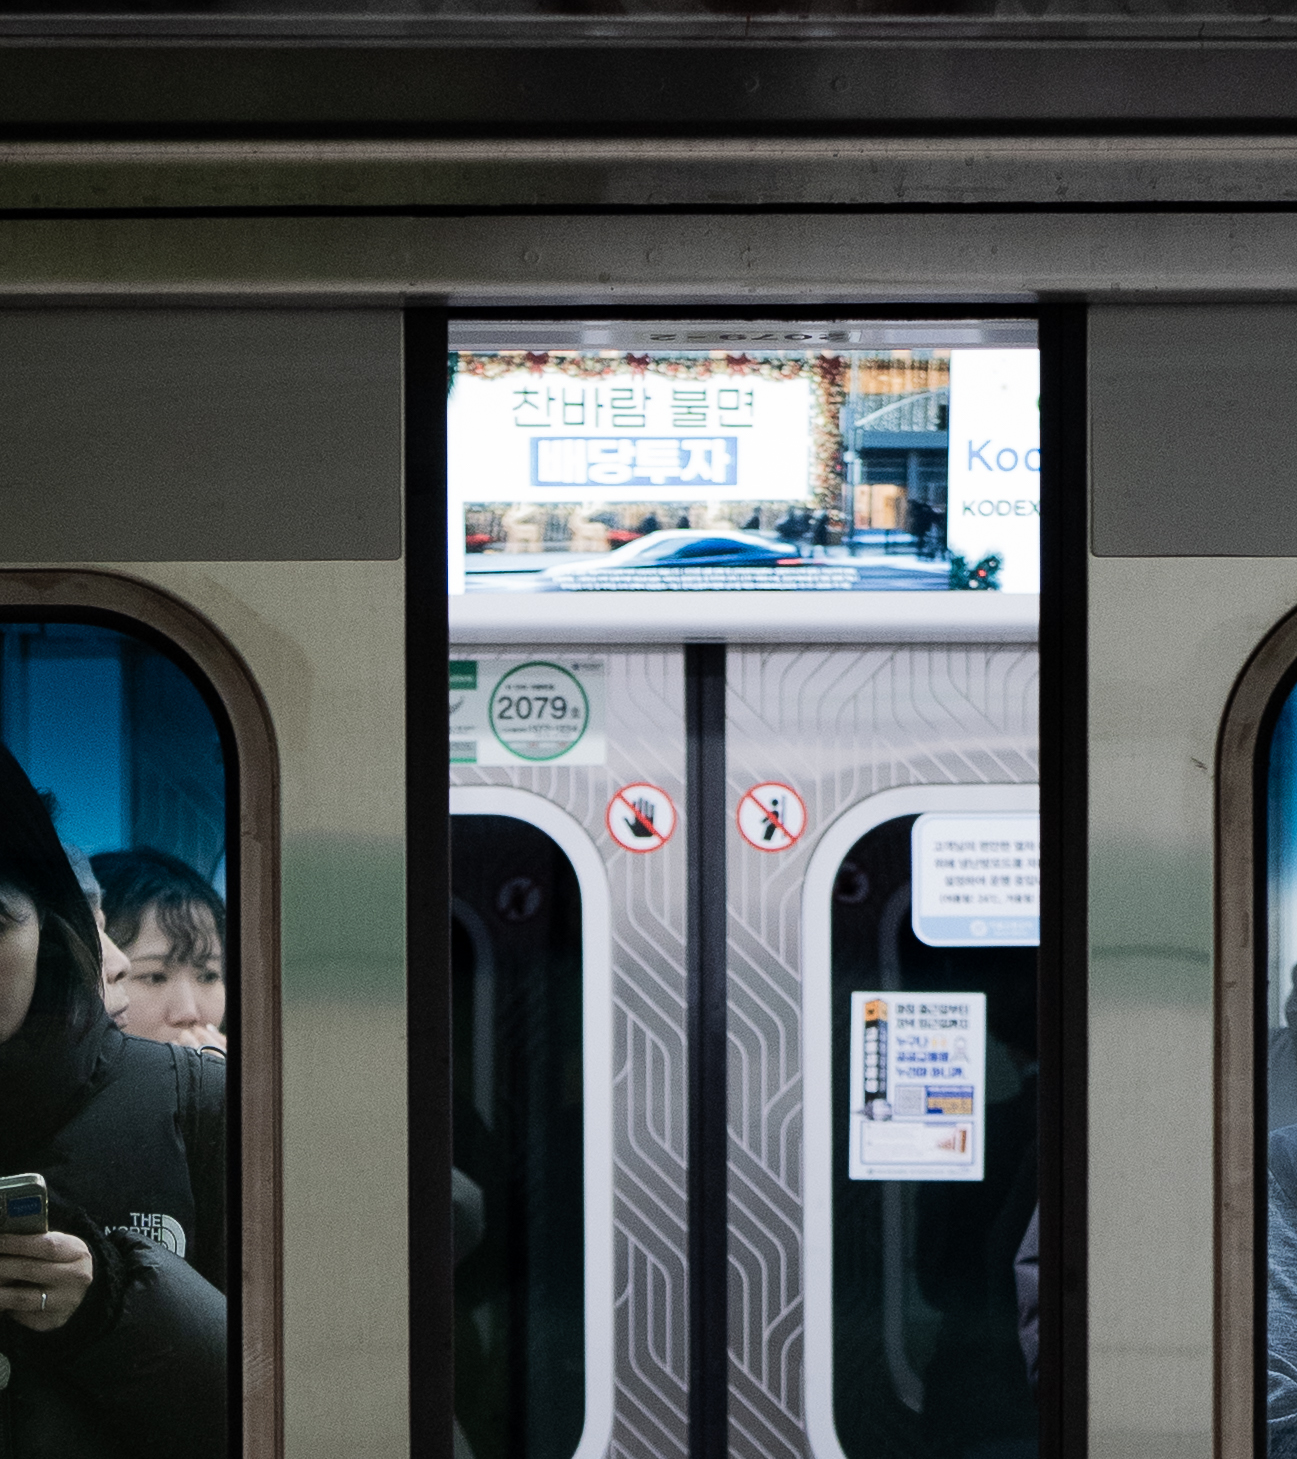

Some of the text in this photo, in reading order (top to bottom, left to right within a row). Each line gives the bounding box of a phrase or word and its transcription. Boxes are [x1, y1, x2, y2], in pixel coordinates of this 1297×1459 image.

[511, 386, 755, 429] 찬바람 불면
[536, 437, 732, 484] 배당투자
[129, 1212, 162, 1227] THE
